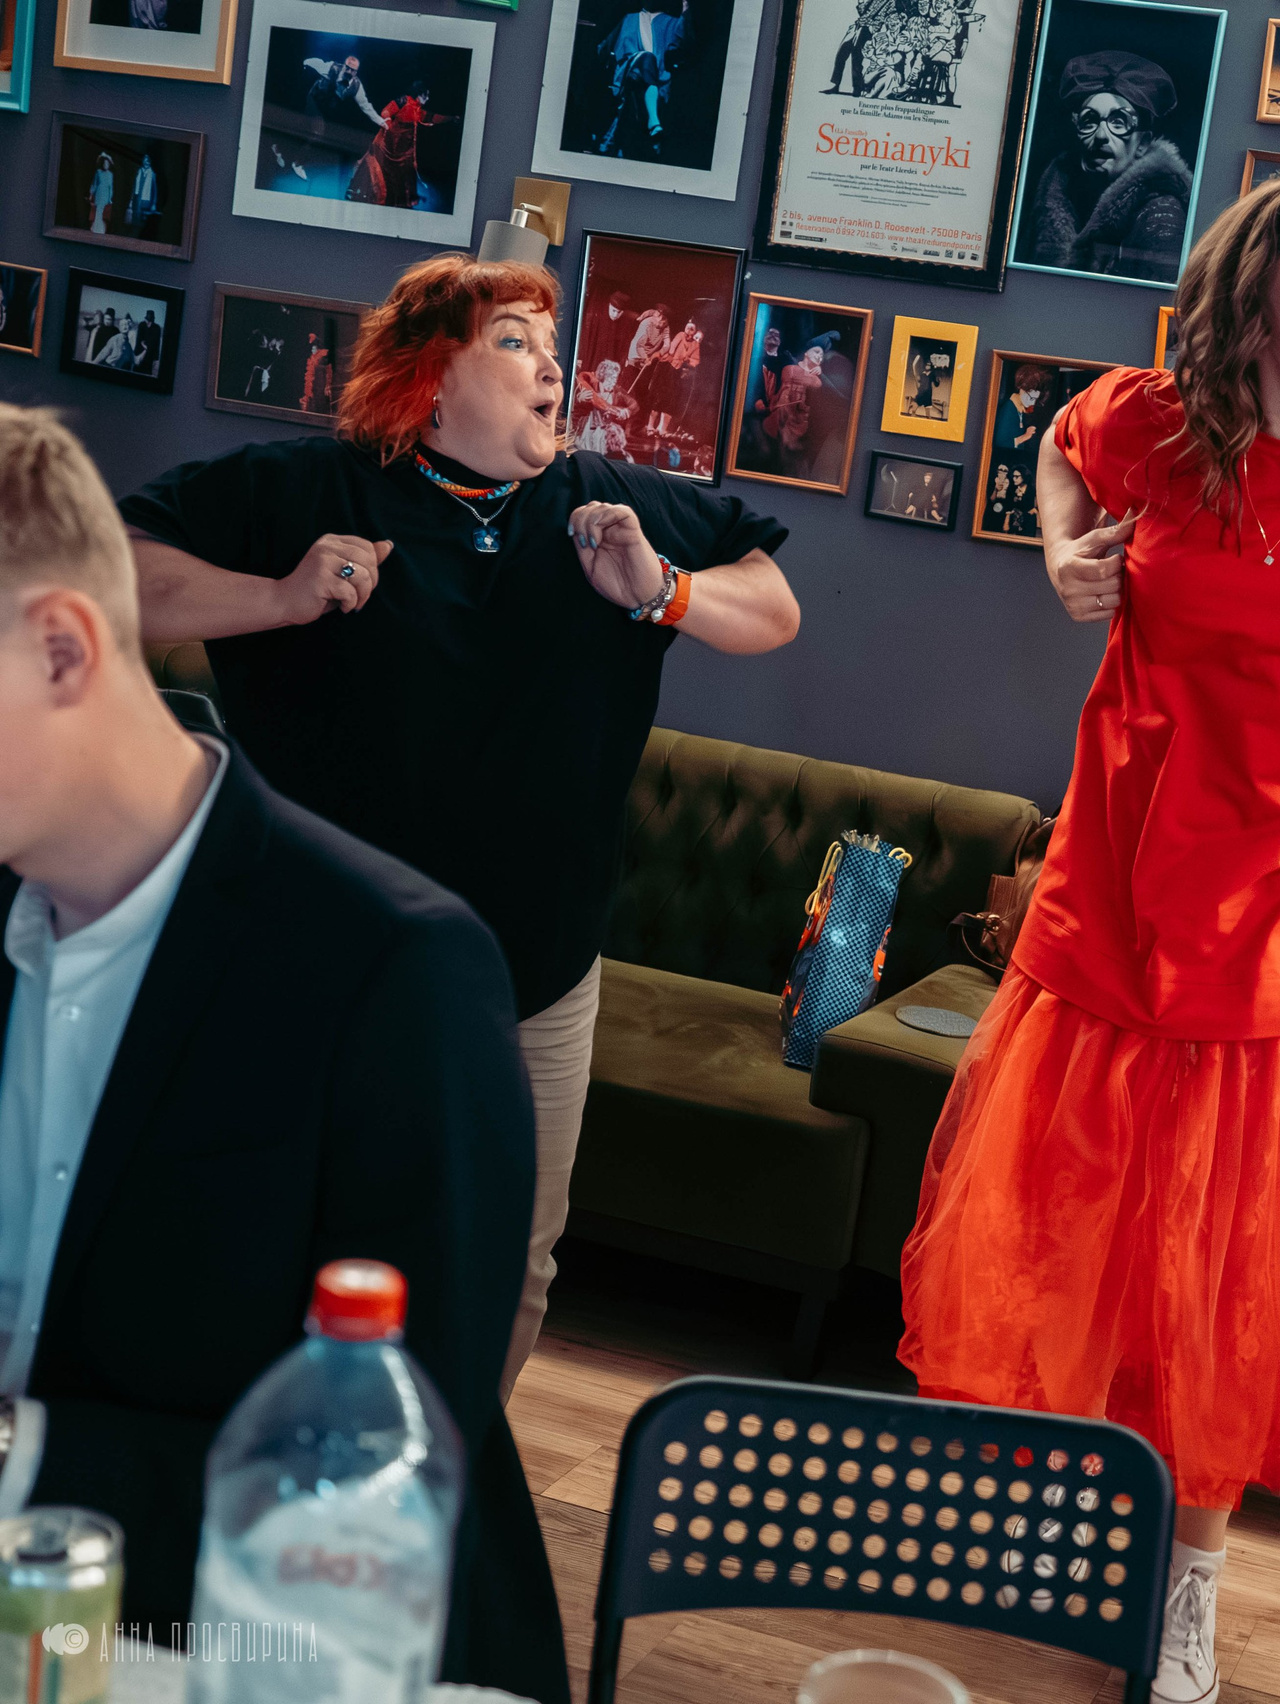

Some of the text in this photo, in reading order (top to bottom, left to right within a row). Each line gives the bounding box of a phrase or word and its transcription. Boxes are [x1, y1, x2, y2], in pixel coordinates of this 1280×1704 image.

[880, 103, 894, 112] plus
[859, 108, 881, 117] famille
[816, 122, 971, 176] Semianyki
[860, 163, 872, 171] par
[781, 209, 788, 219] 2
[807, 214, 838, 225] avenue
[839, 216, 873, 228] Franklin
[884, 221, 926, 235] Roosevelt
[931, 226, 959, 239] 75008
[960, 230, 983, 242] Paris
